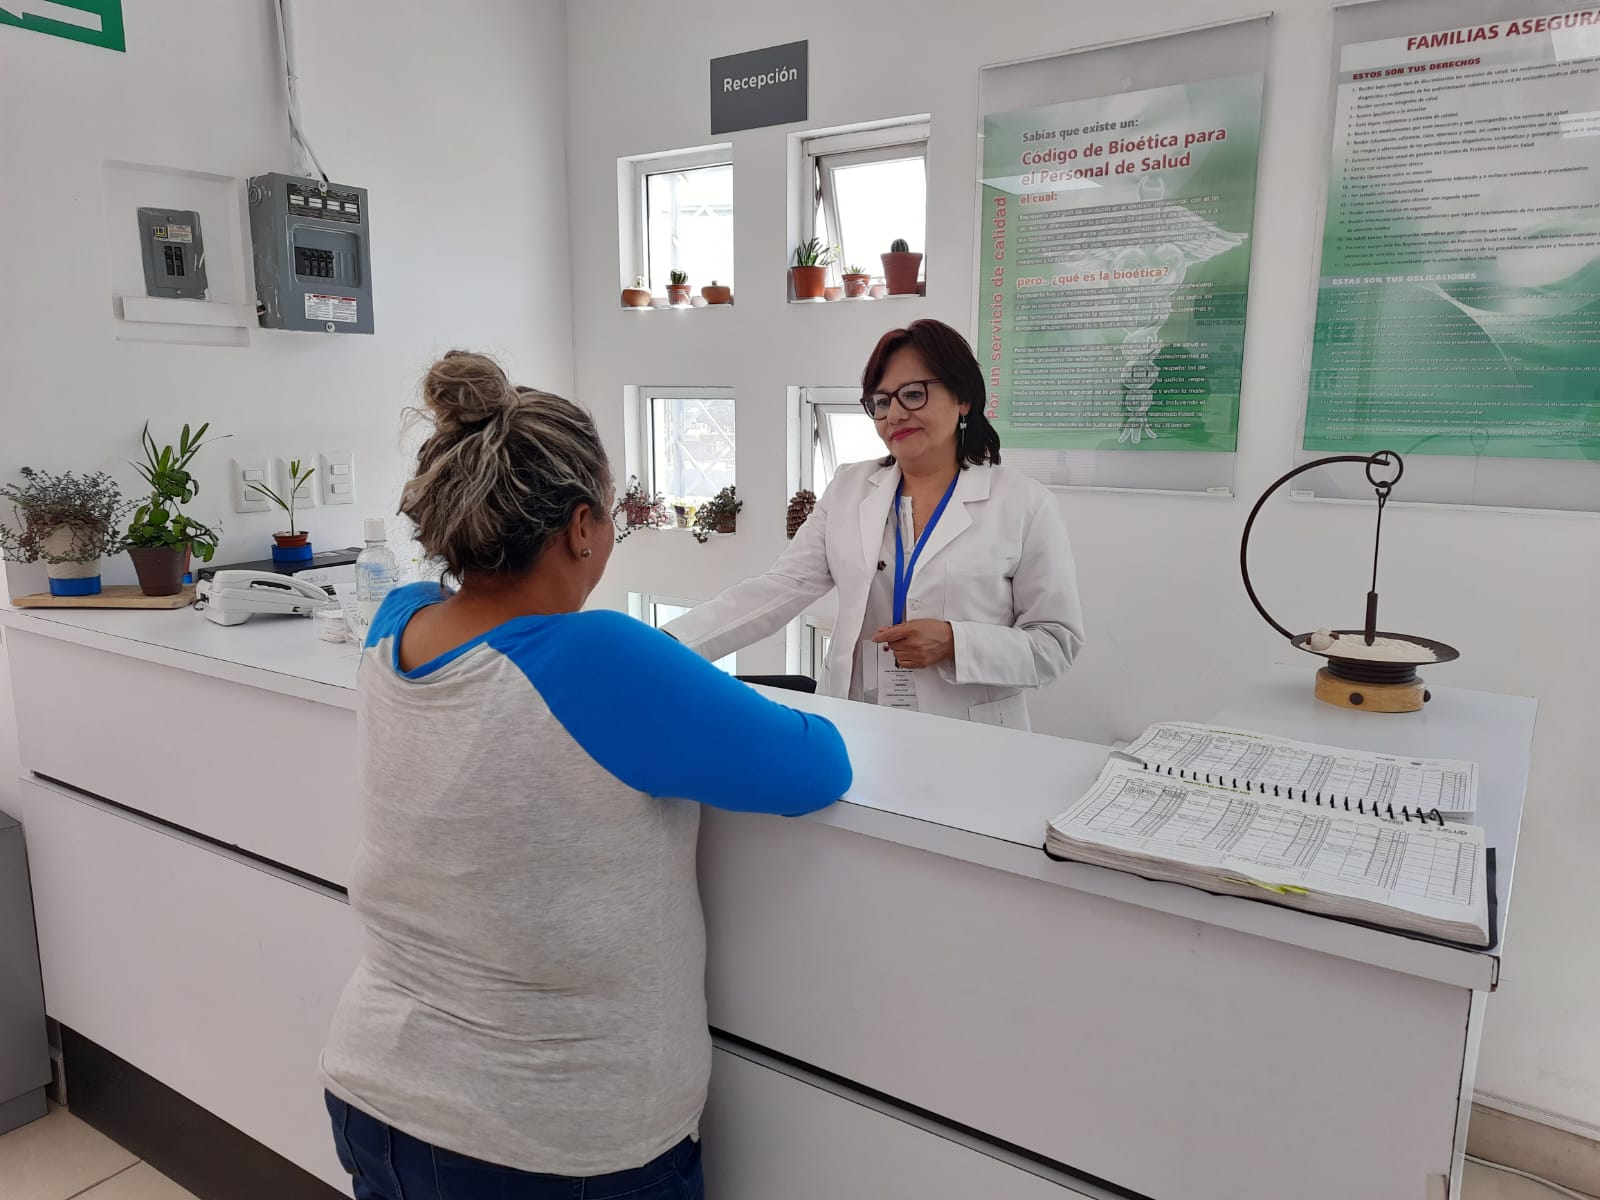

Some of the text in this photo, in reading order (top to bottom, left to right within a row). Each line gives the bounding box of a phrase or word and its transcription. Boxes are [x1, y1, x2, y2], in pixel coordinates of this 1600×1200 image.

[1407, 25, 1499, 51] FAMILIAS
[723, 66, 798, 93] Recepción
[1352, 57, 1481, 80] ESTOS SON TUS DERECHOS
[1022, 118, 1139, 143] Sabías que existe un:
[1022, 128, 1226, 168] Código de Bioética para
[1021, 152, 1191, 186] el Personal de Salud
[1020, 192, 1058, 204] el cual:
[1052, 272, 1080, 286] ¿qué
[1083, 273, 1096, 282] es
[1099, 270, 1110, 280] la
[1112, 266, 1169, 280] bioética?
[1332, 272, 1477, 286] ESTAS SON TUS OBLIGACIONES
[987, 195, 1007, 420] Por un servicio de calidad
